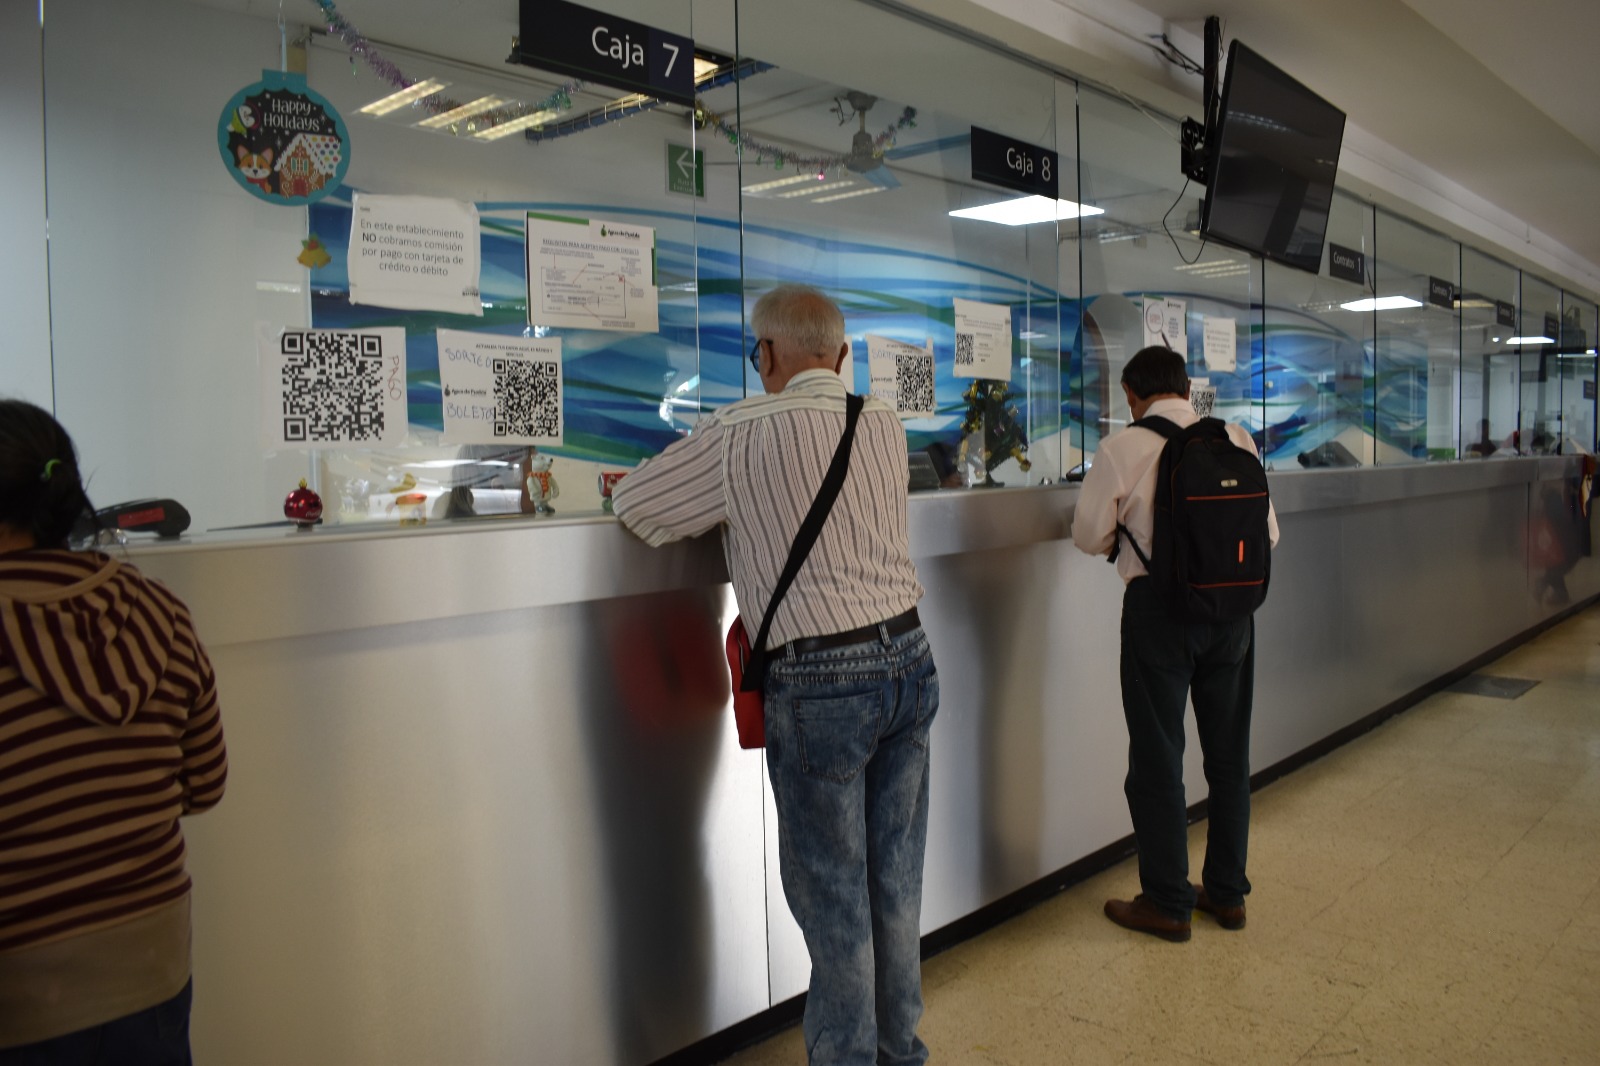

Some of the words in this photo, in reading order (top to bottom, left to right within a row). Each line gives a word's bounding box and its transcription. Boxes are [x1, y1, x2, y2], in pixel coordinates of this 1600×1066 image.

[592, 26, 644, 69] Caja
[663, 42, 679, 78] 7
[272, 98, 311, 117] Happy
[263, 112, 320, 132] Holidays
[1006, 147, 1034, 177] Caja
[1041, 156, 1051, 182] 8
[360, 219, 372, 230] En
[374, 221, 394, 232] este
[396, 222, 464, 240] establecimiento
[362, 232, 377, 243] NO
[379, 235, 422, 249] cobramos
[424, 238, 463, 252] comisión
[362, 247, 378, 257] por
[380, 249, 403, 260] pago
[404, 252, 420, 262] con
[422, 252, 451, 265] tarjeta
[453, 255, 464, 265] de
[1333, 251, 1355, 269] Contratos
[1357, 257, 1361, 273] 1
[379, 261, 411, 273] crédito
[413, 265, 419, 273] o
[420, 264, 449, 277] débito
[1449, 286, 1453, 301] 2
[445, 347, 492, 368] SORTEO
[387, 355, 401, 401] PAGO
